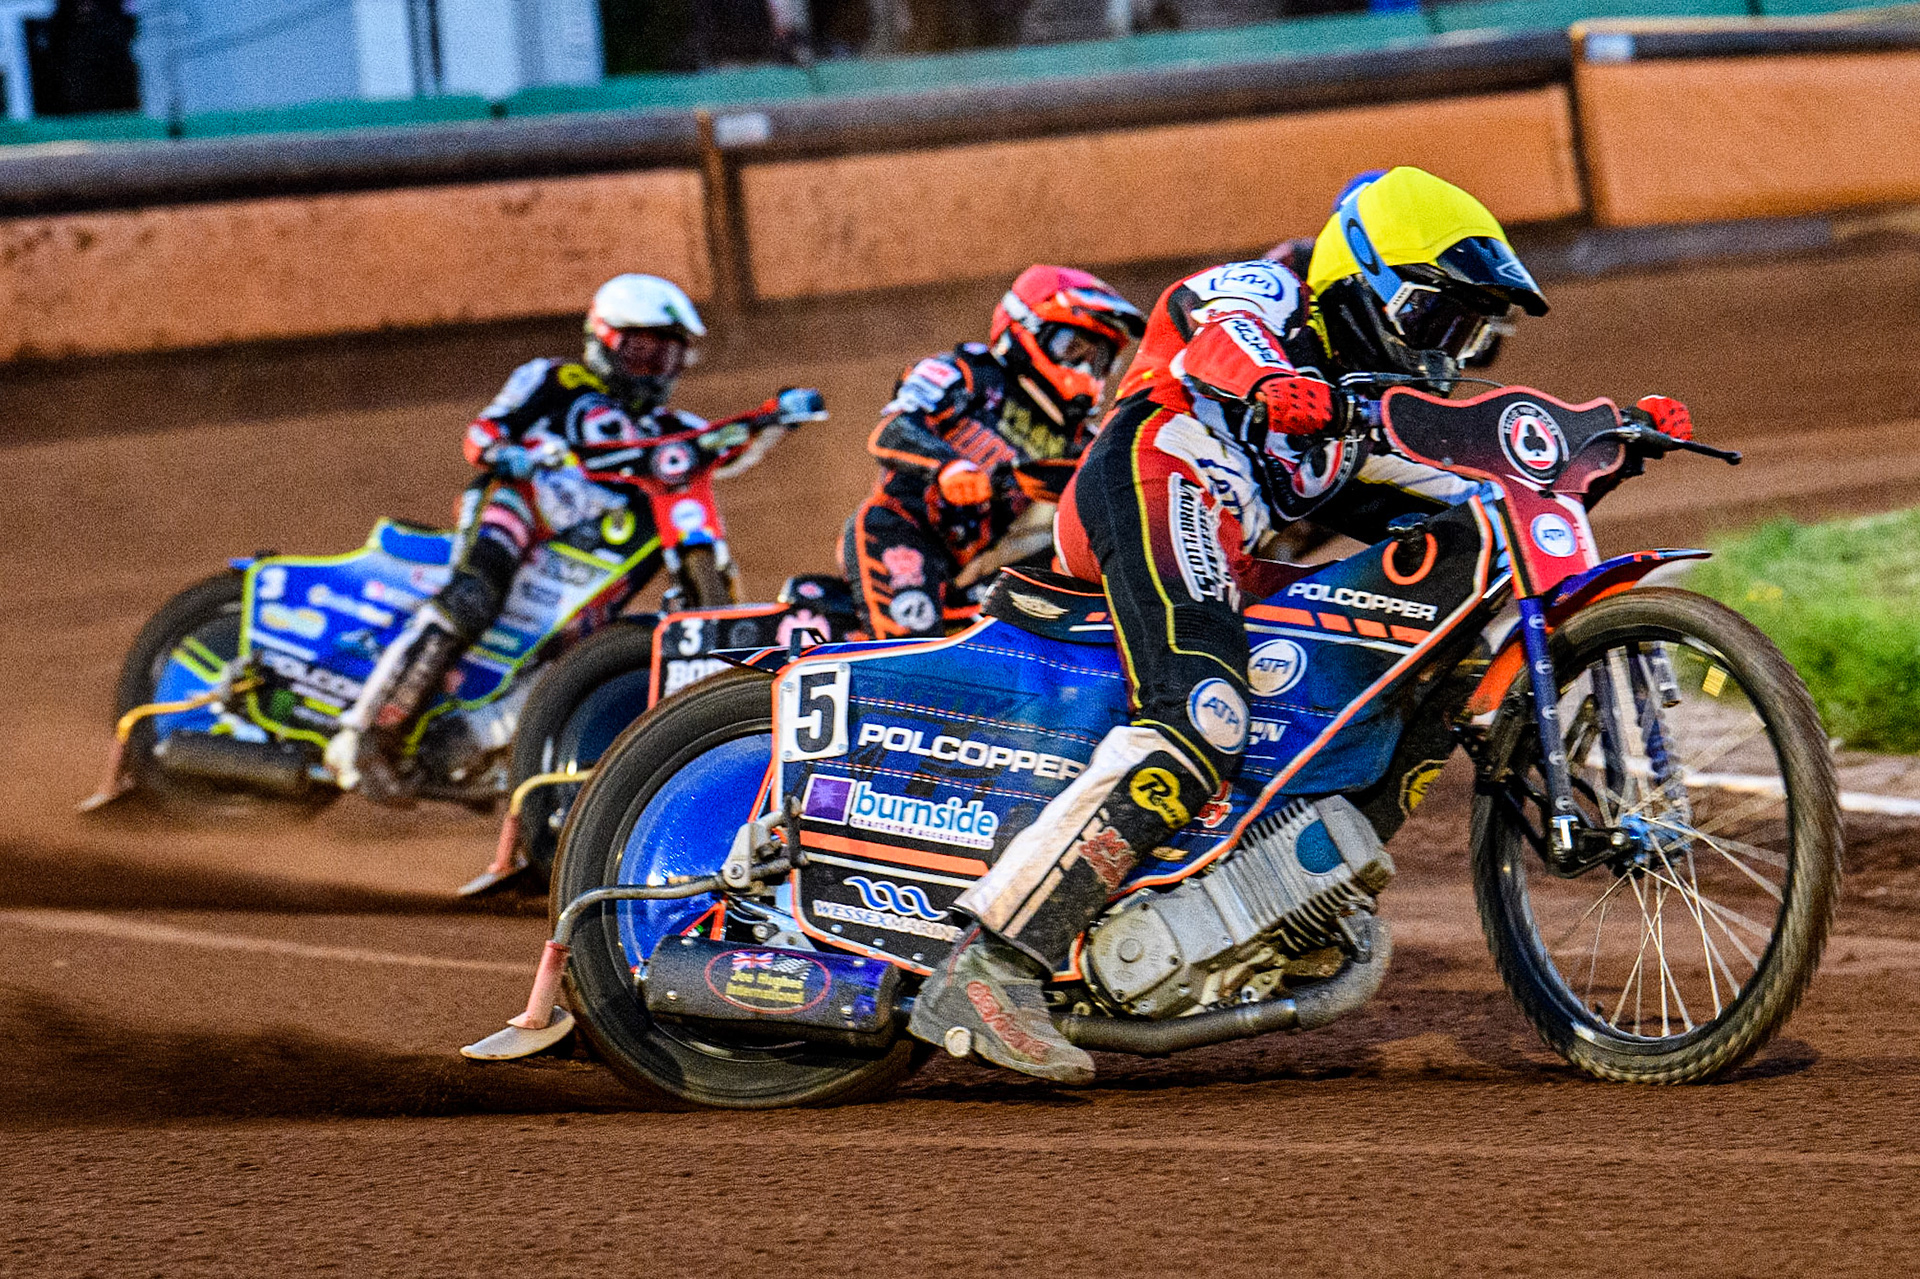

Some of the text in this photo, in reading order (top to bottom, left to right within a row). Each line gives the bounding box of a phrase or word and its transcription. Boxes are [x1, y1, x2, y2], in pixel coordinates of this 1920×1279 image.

[1287, 582, 1438, 621] POLCOPPER
[678, 618, 704, 657] 3
[1253, 656, 1293, 675] ATPI
[795, 671, 838, 753] 5
[855, 781, 994, 836] burnside
